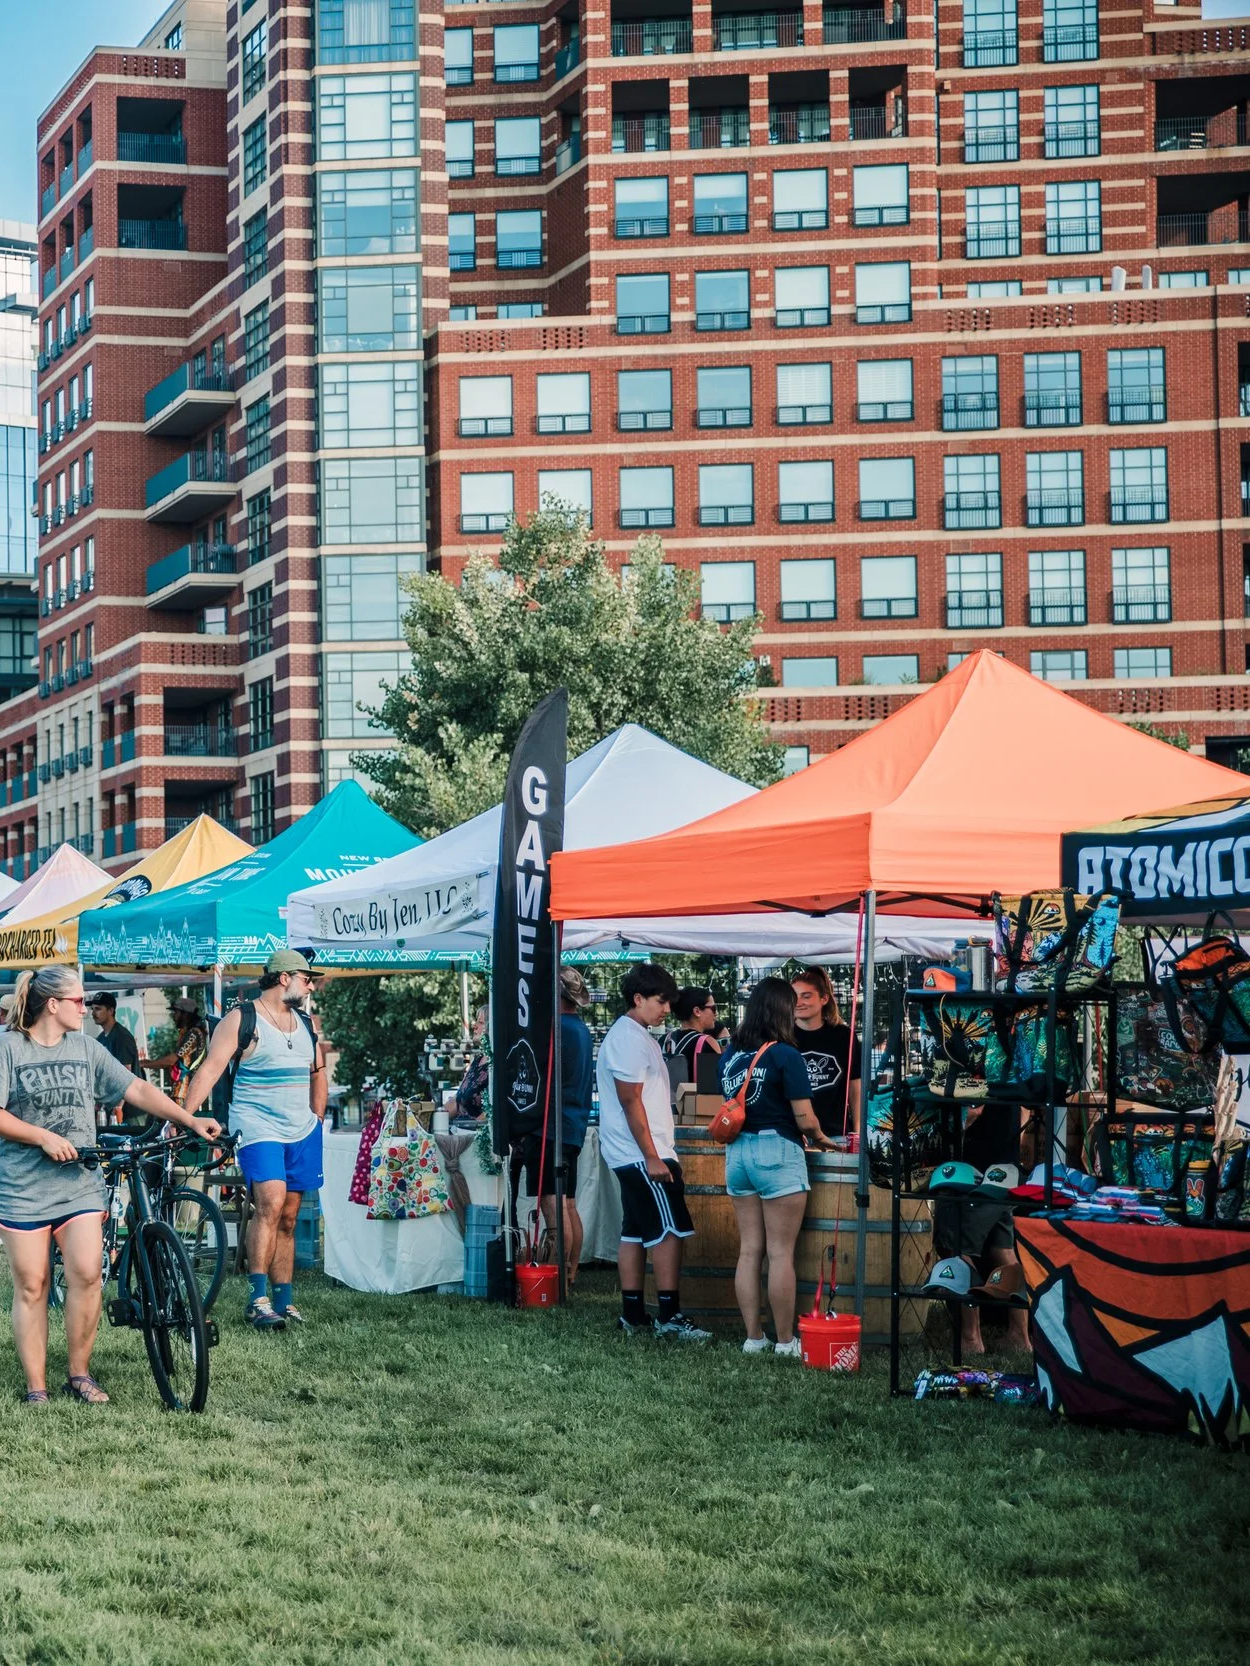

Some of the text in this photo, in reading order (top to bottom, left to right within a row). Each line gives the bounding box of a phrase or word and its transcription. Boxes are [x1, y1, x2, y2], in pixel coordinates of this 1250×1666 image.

[339, 854, 370, 862] NEW
[516, 765, 548, 1028] GAMES
[332, 906, 367, 938] Cozy
[368, 901, 389, 939] By
[40, 927, 57, 959] TEA
[19, 1064, 88, 1094] PHISH
[723, 1067, 765, 1095] BLUE MON
[33, 1088, 85, 1108] JUNTA
